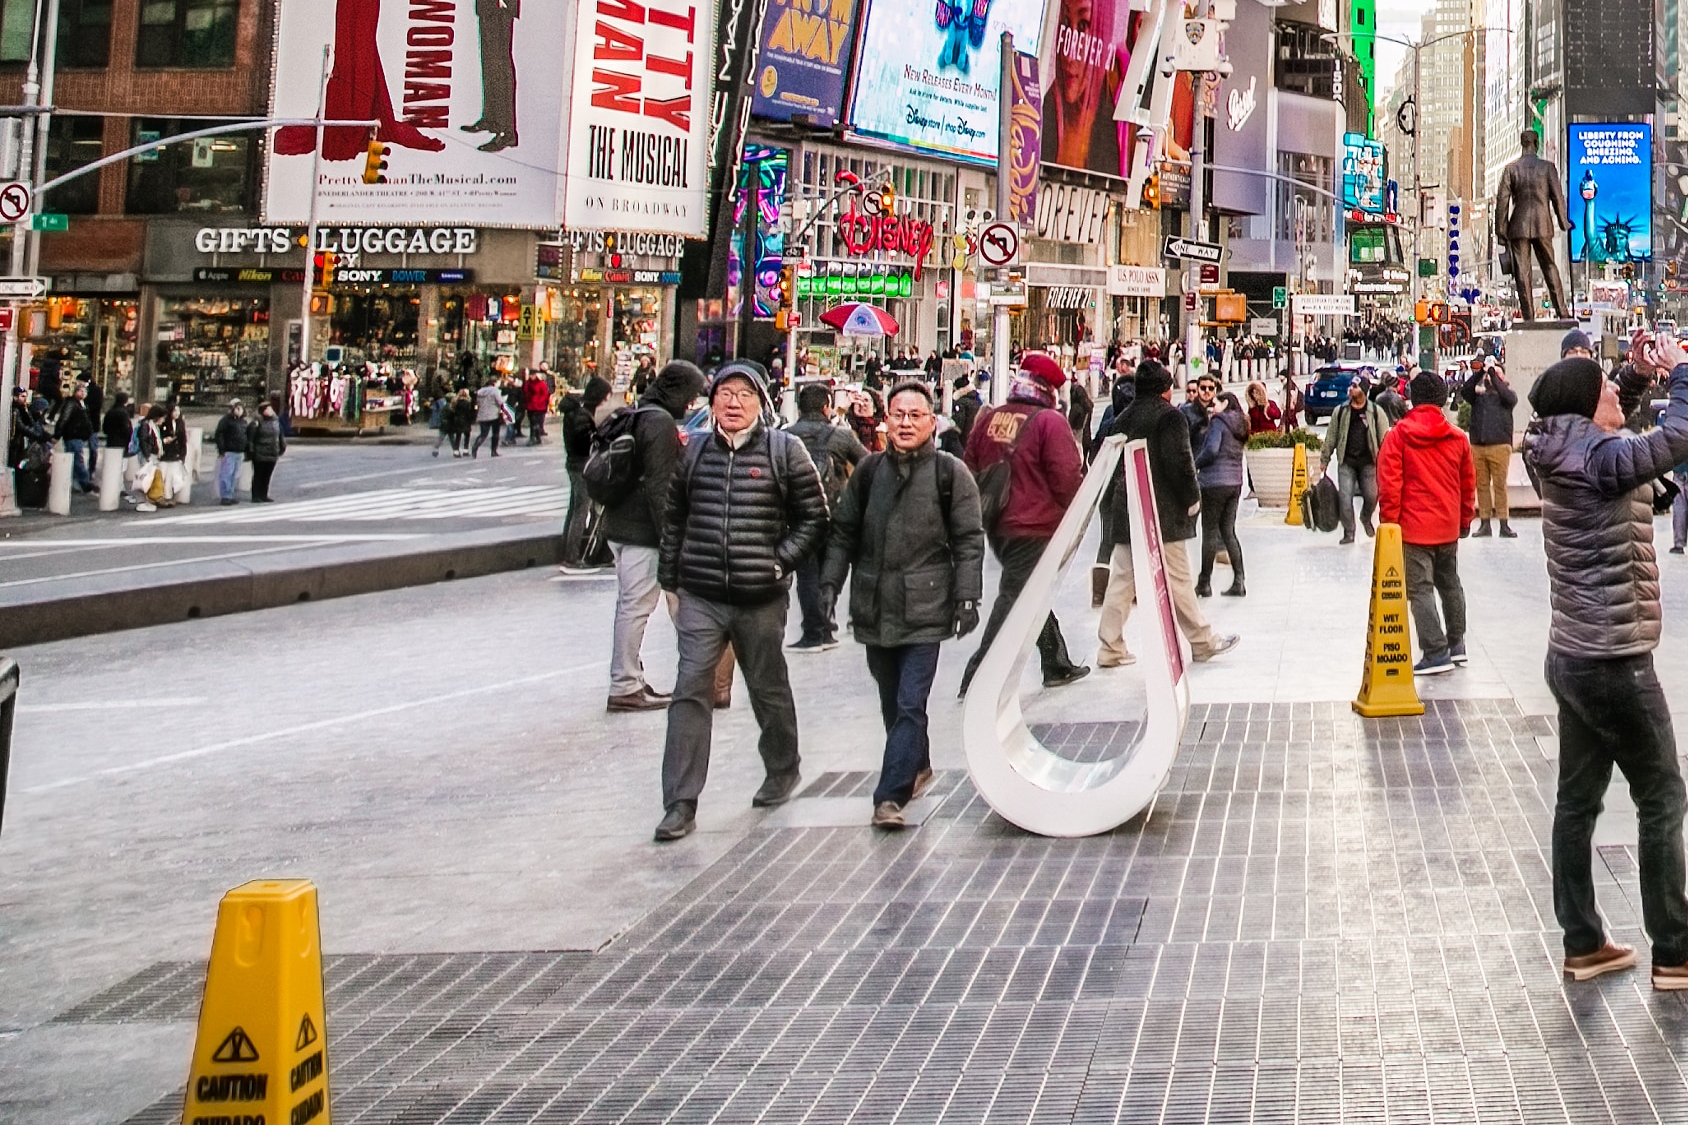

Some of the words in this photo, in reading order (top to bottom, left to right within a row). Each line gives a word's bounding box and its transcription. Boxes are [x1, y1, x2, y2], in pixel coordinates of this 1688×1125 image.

[767, 9, 848, 65] AWAY
[1056, 25, 1103, 68] FOREVER
[1105, 47, 1117, 71] 21
[1578, 131, 1616, 140] LIBERTY
[1617, 131, 1644, 140] FROM
[1584, 140, 1638, 149] COUGHING,
[589, 124, 616, 181] THE
[622, 128, 689, 189] MUSICAL
[1602, 156, 1642, 164] ACHING.
[586, 195, 606, 211] ON
[611, 198, 688, 219] BROADWAY
[194, 228, 291, 255] GIFTS
[318, 227, 477, 255] LUGGAGE
[617, 233, 685, 258] LUGGAGE
[1175, 243, 1189, 254] ONE
[1198, 246, 1215, 258] WAY
[238, 269, 272, 282] Nikon
[338, 270, 382, 282] SONY
[392, 271, 426, 282] BOWER
[604, 271, 630, 283] Canon
[634, 271, 659, 283] SONY
[1117, 268, 1127, 281] U.S.
[1129, 269, 1144, 282] POLO
[1046, 286, 1081, 309] FOREVER
[1382, 580, 1402, 588] CAUTION
[1384, 614, 1399, 623] WET
[1379, 626, 1403, 634] FLOOR
[1383, 643, 1400, 651] PISO
[1376, 653, 1408, 663] MOJADO
[290, 1050, 323, 1093] CAUTION
[196, 1074, 268, 1103] CAUTION
[290, 1088, 324, 1125] CUIDADO
